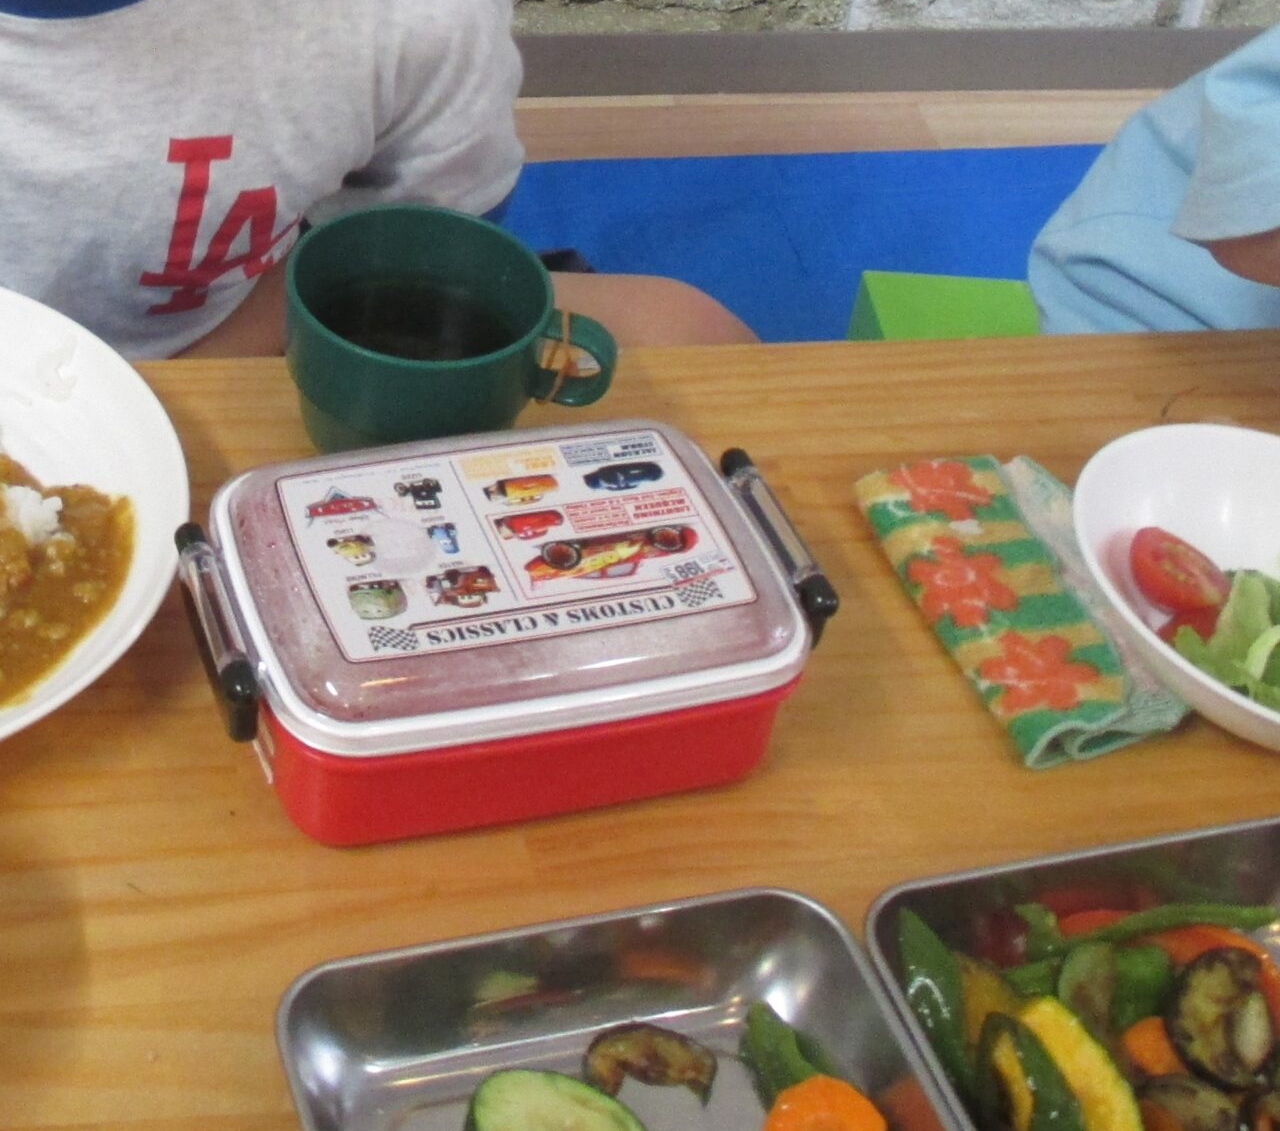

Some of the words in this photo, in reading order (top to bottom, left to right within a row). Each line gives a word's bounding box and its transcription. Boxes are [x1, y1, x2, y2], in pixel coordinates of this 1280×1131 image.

[138, 135, 301, 316] LA
[541, 611, 559, 627] &
[566, 595, 676, 624] CUSTOMS
[426, 615, 539, 646] CLASSICS
